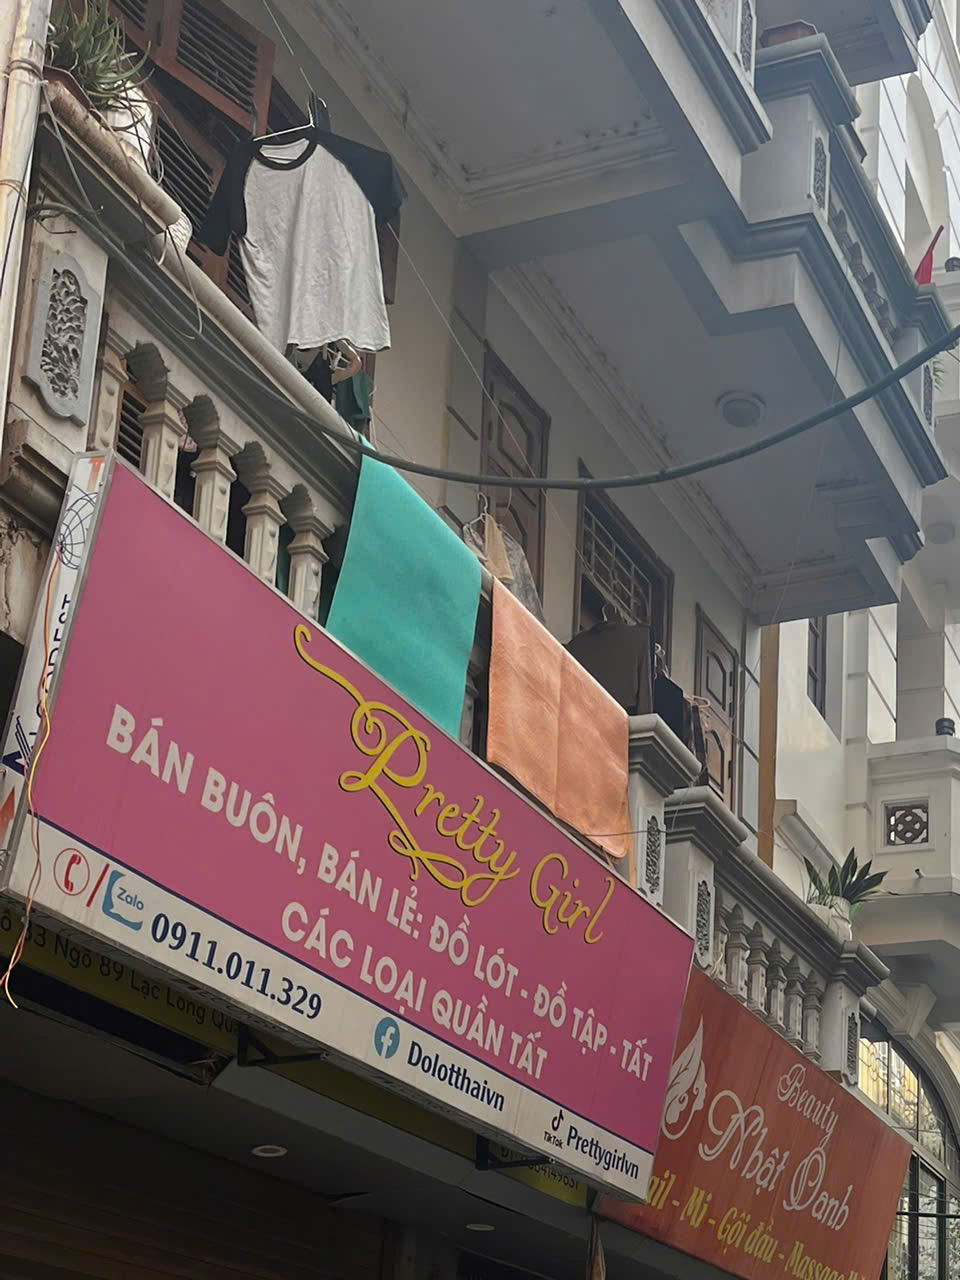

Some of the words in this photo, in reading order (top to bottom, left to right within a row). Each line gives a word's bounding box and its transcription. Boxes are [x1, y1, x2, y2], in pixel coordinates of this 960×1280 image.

[293, 624, 521, 907] Pretty
[529, 852, 615, 945] Girl
[106, 703, 195, 795] BÁN
[200, 766, 307, 876] BUÔN,
[316, 842, 383, 913] BÁN
[386, 885, 424, 939] LẺ:
[428, 913, 470, 967] ĐỒ
[473, 944, 520, 998] LÓT
[532, 981, 569, 1029] ĐỒ
[571, 1008, 608, 1055] TẬP
[618, 1038, 654, 1083] TẤT
[99, 957, 125, 983] 89
[129, 970, 162, 1001] Lạc
[166, 987, 207, 1025] Long
[116, 886, 145, 912] Zalo
[151, 912, 323, 1020] 0911.011.329
[281, 901, 355, 969] CÁC
[359, 944, 427, 1015] LOẠI
[431, 994, 505, 1057] QUẦN
[508, 1031, 549, 1081] TẤT
[406, 1040, 506, 1112] Dolotthaivn
[776, 1063, 839, 1148] Beauty
[543, 1130, 564, 1150] TikTok
[566, 1125, 640, 1180] Prettygirlvn
[648, 1169, 676, 1210] ail
[698, 1089, 787, 1196] Nhật
